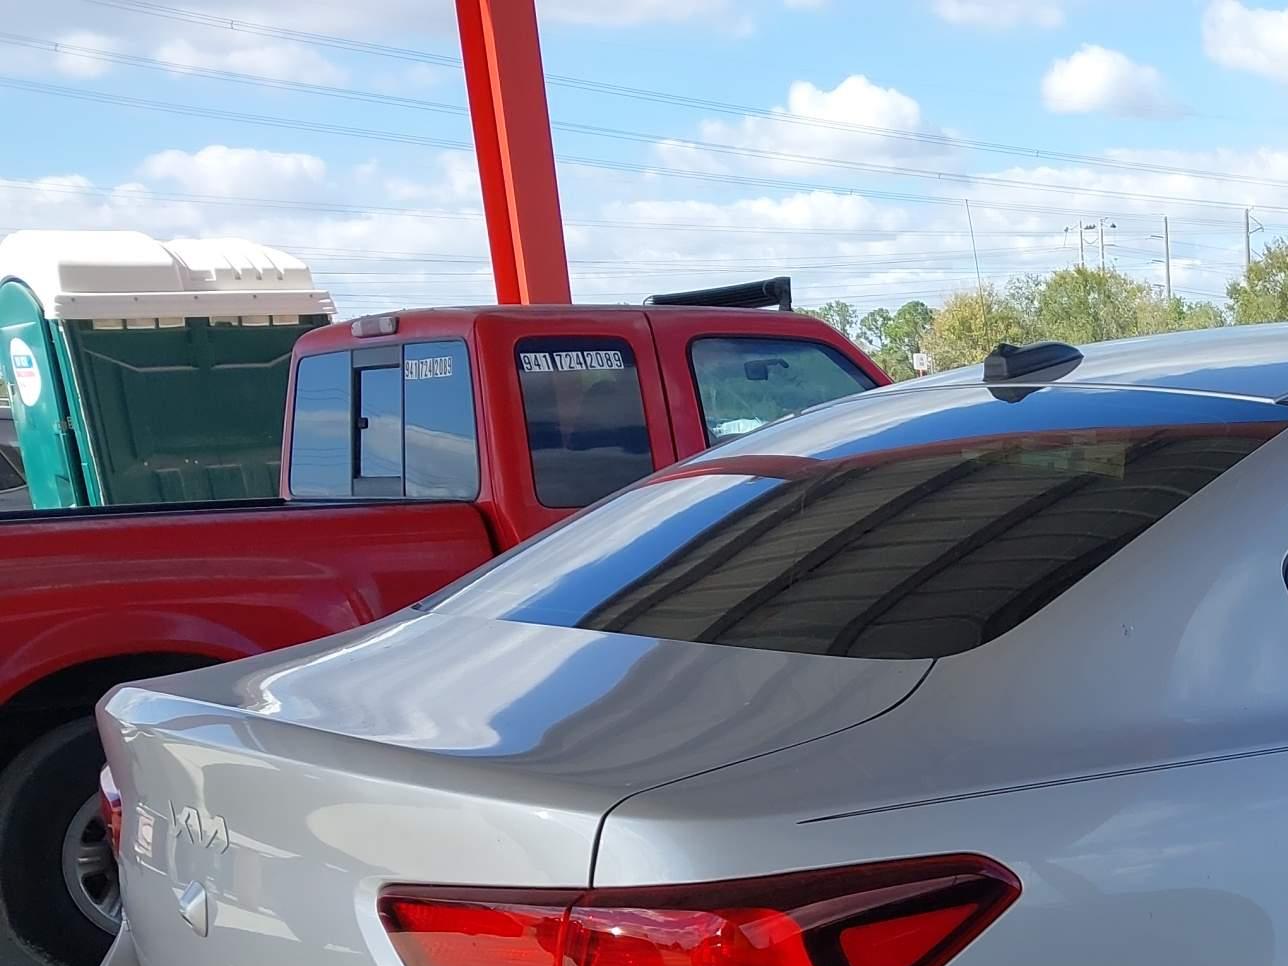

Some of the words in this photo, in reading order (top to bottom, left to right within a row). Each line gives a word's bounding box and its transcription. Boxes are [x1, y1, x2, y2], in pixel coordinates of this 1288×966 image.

[405, 361, 418, 378] 941
[420, 359, 432, 378] 724
[523, 353, 552, 371] 941
[555, 353, 585, 370] 724
[586, 351, 623, 369] 2089
